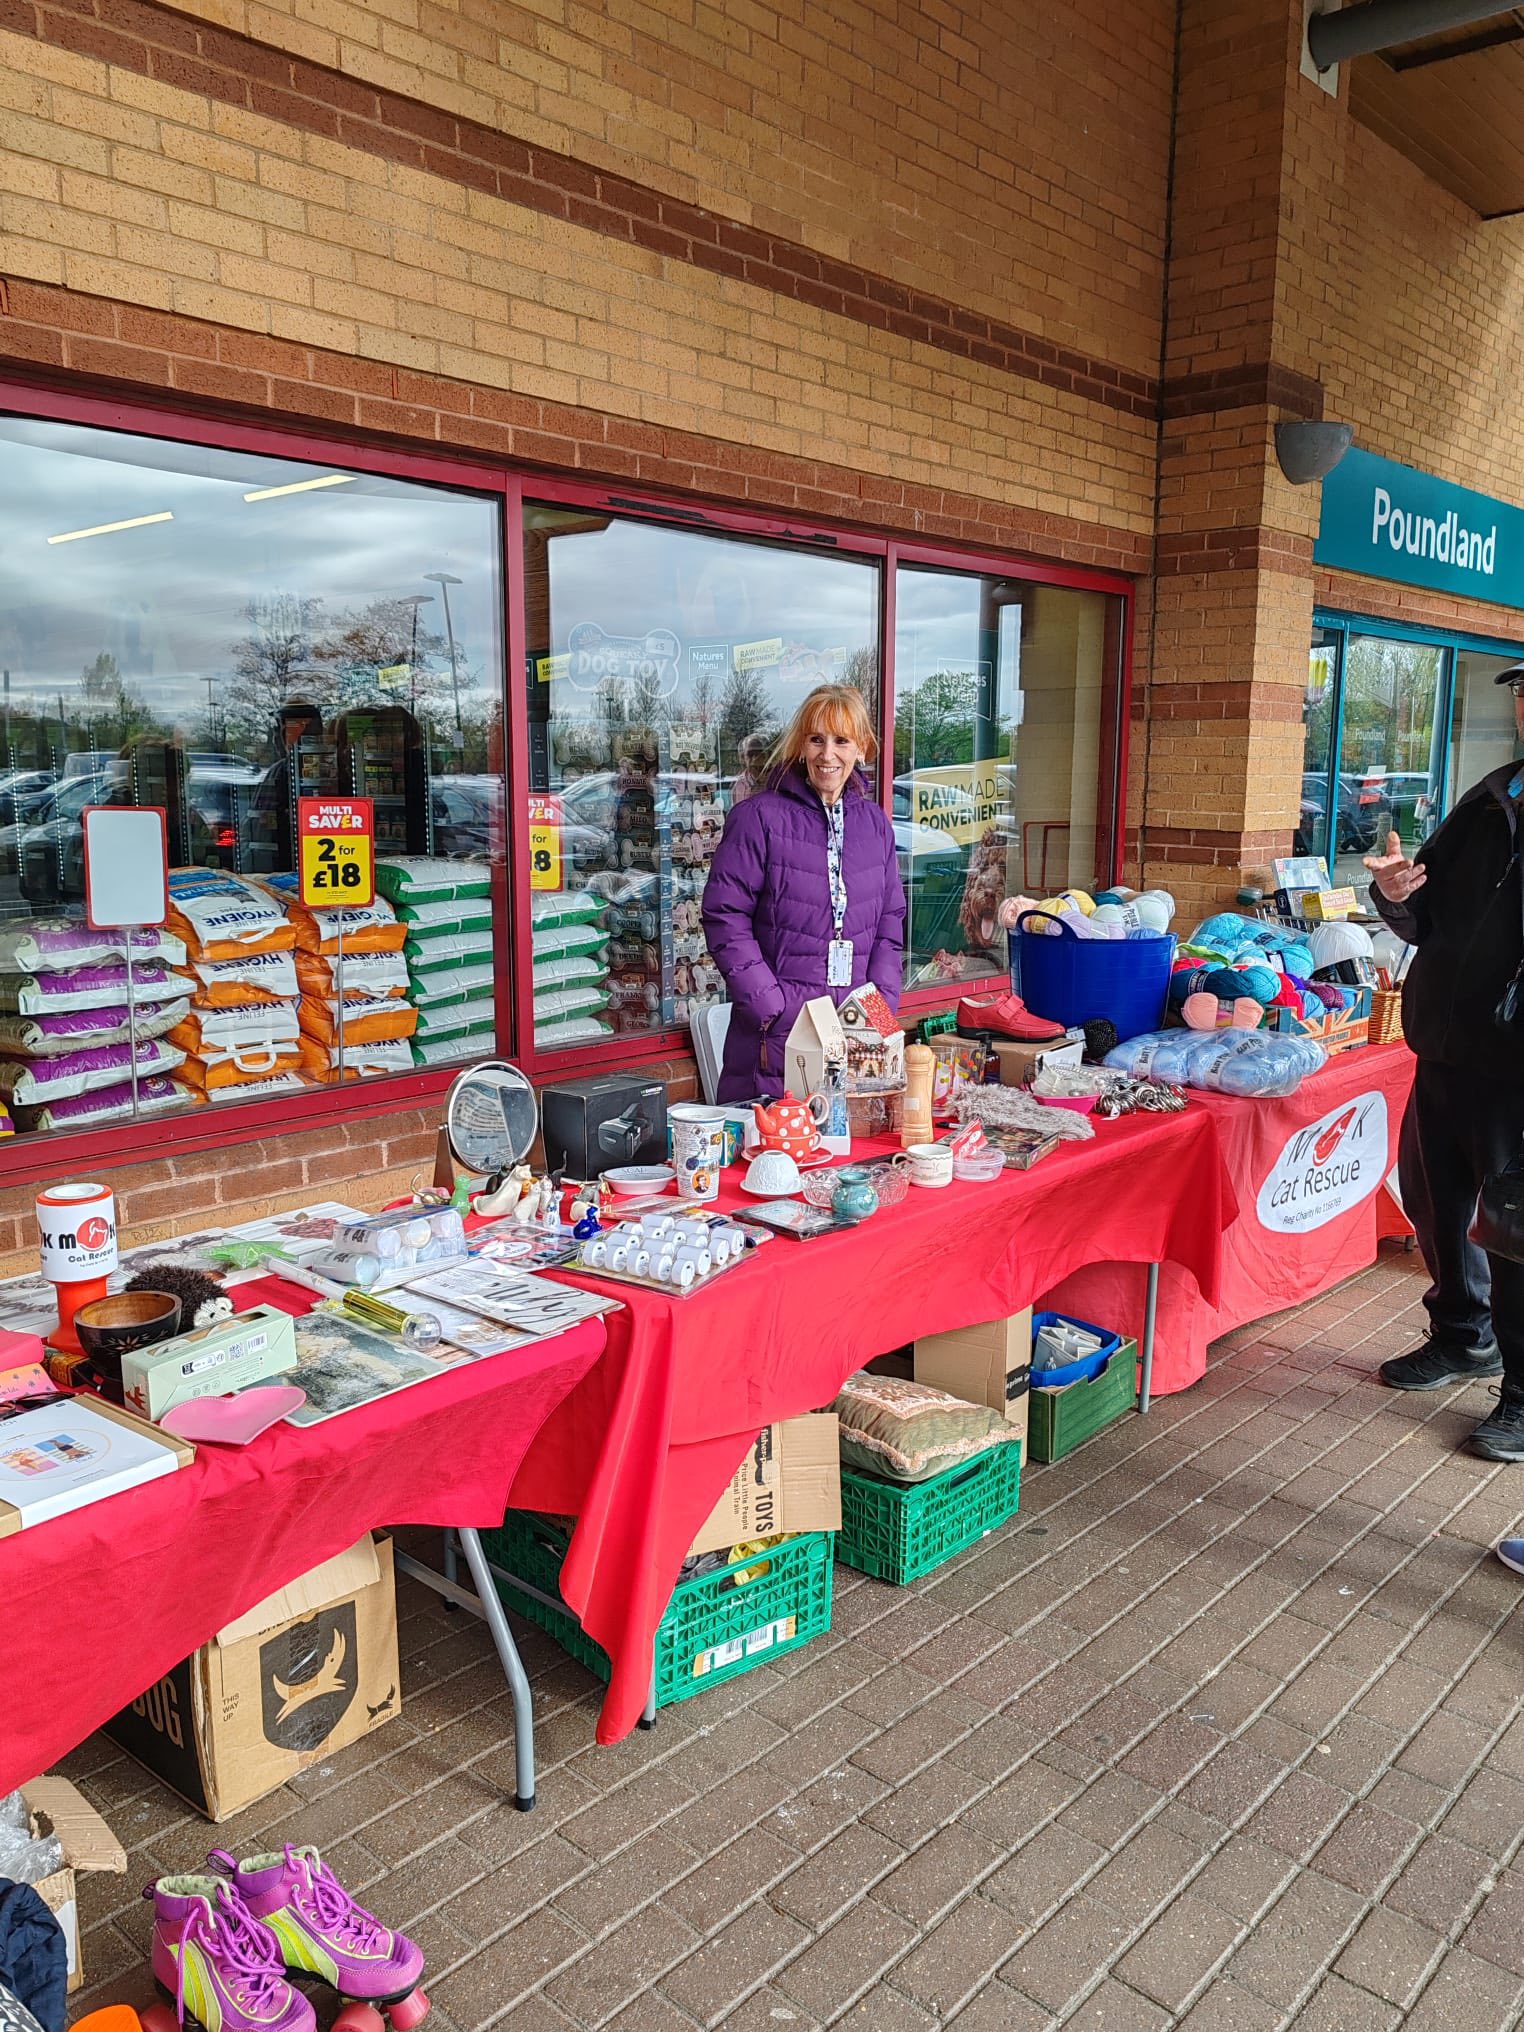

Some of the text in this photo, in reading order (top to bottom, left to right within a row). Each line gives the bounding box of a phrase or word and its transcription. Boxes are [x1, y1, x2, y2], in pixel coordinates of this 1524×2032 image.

[1372, 487, 1497, 575] Poundland
[692, 653, 724, 662] Natures
[577, 651, 617, 675] DOG
[626, 658, 668, 682] TOY
[698, 661, 719, 671] Menu
[1355, 727, 1386, 741] Poundland
[320, 806, 352, 815] MULTI
[919, 802, 1005, 833] CONVENIENT
[309, 815, 363, 829] SAVER
[532, 833, 548, 844] for
[317, 838, 356, 862] 2 for
[313, 863, 361, 888] £18
[1347, 873, 1373, 885] Poundla
[203, 910, 278, 927] HYGIENE
[239, 965, 266, 975] FELINE
[363, 959, 385, 969] FELINE
[236, 1010, 265, 1021] FELINE
[1139, 1043, 1151, 1065] BABY
[1234, 1043, 1252, 1055] BABY
[1211, 1059, 1223, 1075] BABY
[1271, 1159, 1361, 1209] Cat Rescue
[1283, 1215, 1296, 1225] Reg
[1295, 1207, 1315, 1222] Charity
[68, 1250, 87, 1263] Cat
[88, 1247, 114, 1260] Rescue
[760, 1428, 770, 1463] fisher-p
[741, 1463, 749, 1531] Price Little People
[733, 1498, 741, 1515] Train
[755, 1490, 774, 1534] TOYS
[222, 1692, 240, 1706] THIS
[222, 1701, 239, 1714] WAY
[223, 1712, 234, 1722] UP
[368, 1710, 394, 1728] FRAGILE
